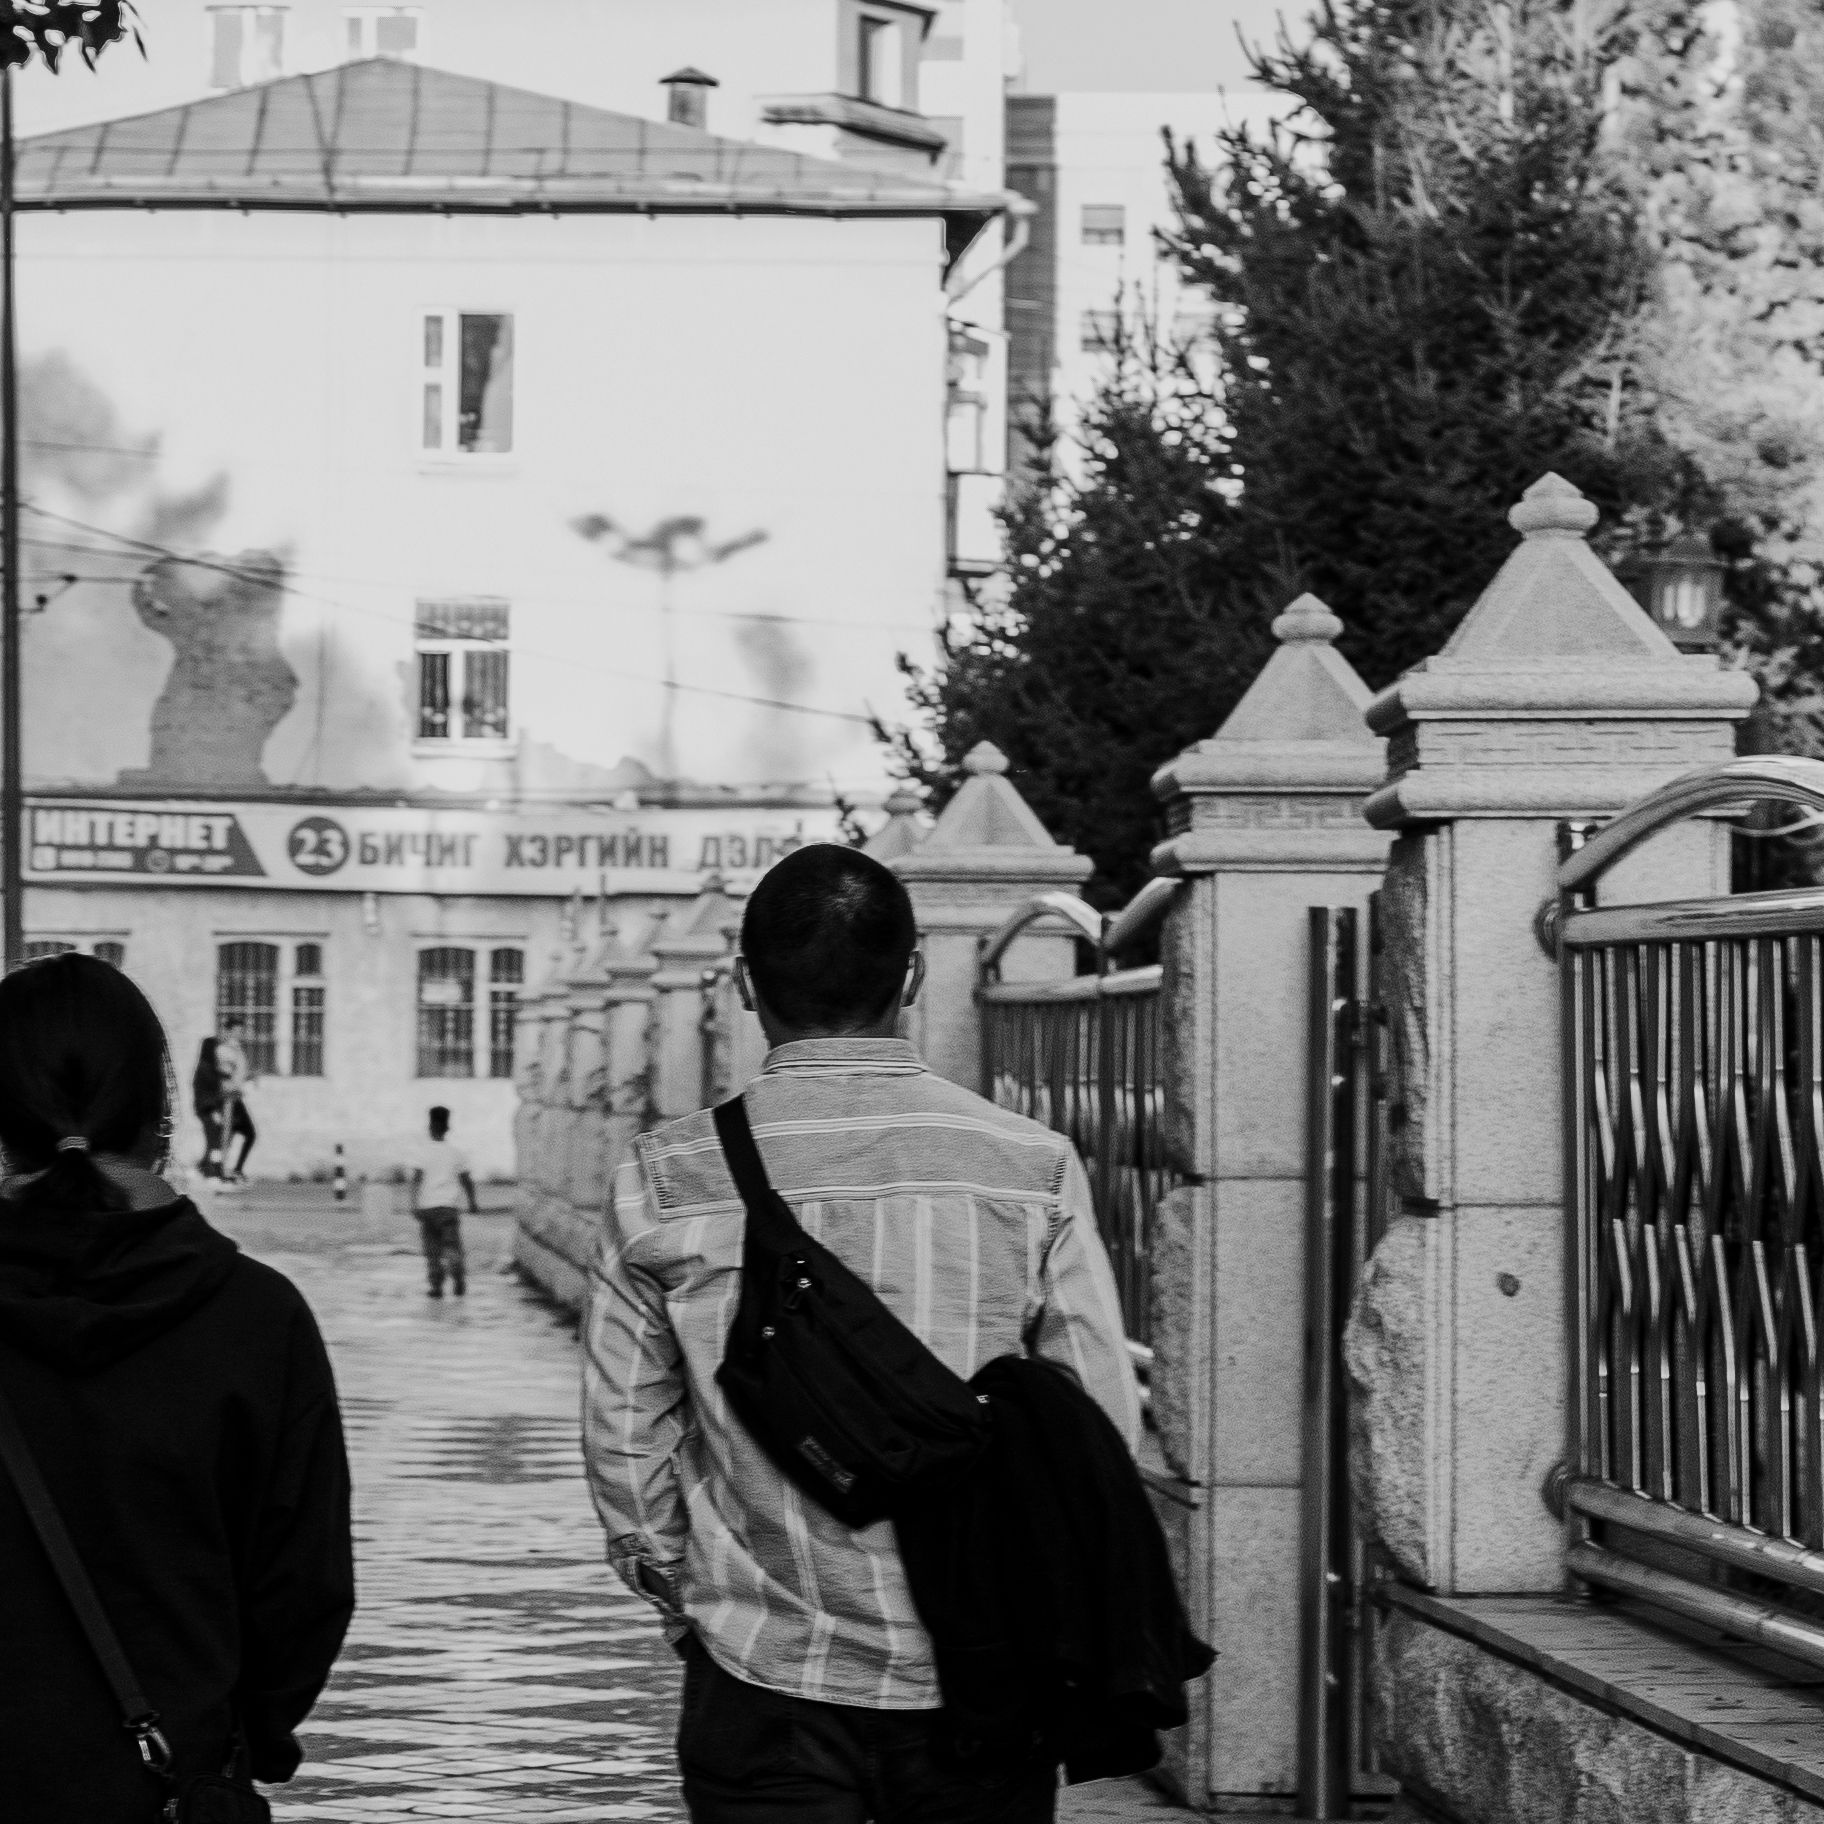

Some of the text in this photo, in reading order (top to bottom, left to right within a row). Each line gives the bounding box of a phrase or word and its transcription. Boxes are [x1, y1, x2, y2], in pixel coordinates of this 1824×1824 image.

[34, 809, 233, 850] ИНТЕРНЕТ
[294, 828, 346, 866] 23
[359, 833, 478, 867] БИЧИГ
[505, 827, 668, 868] ХЭРГИЙН
